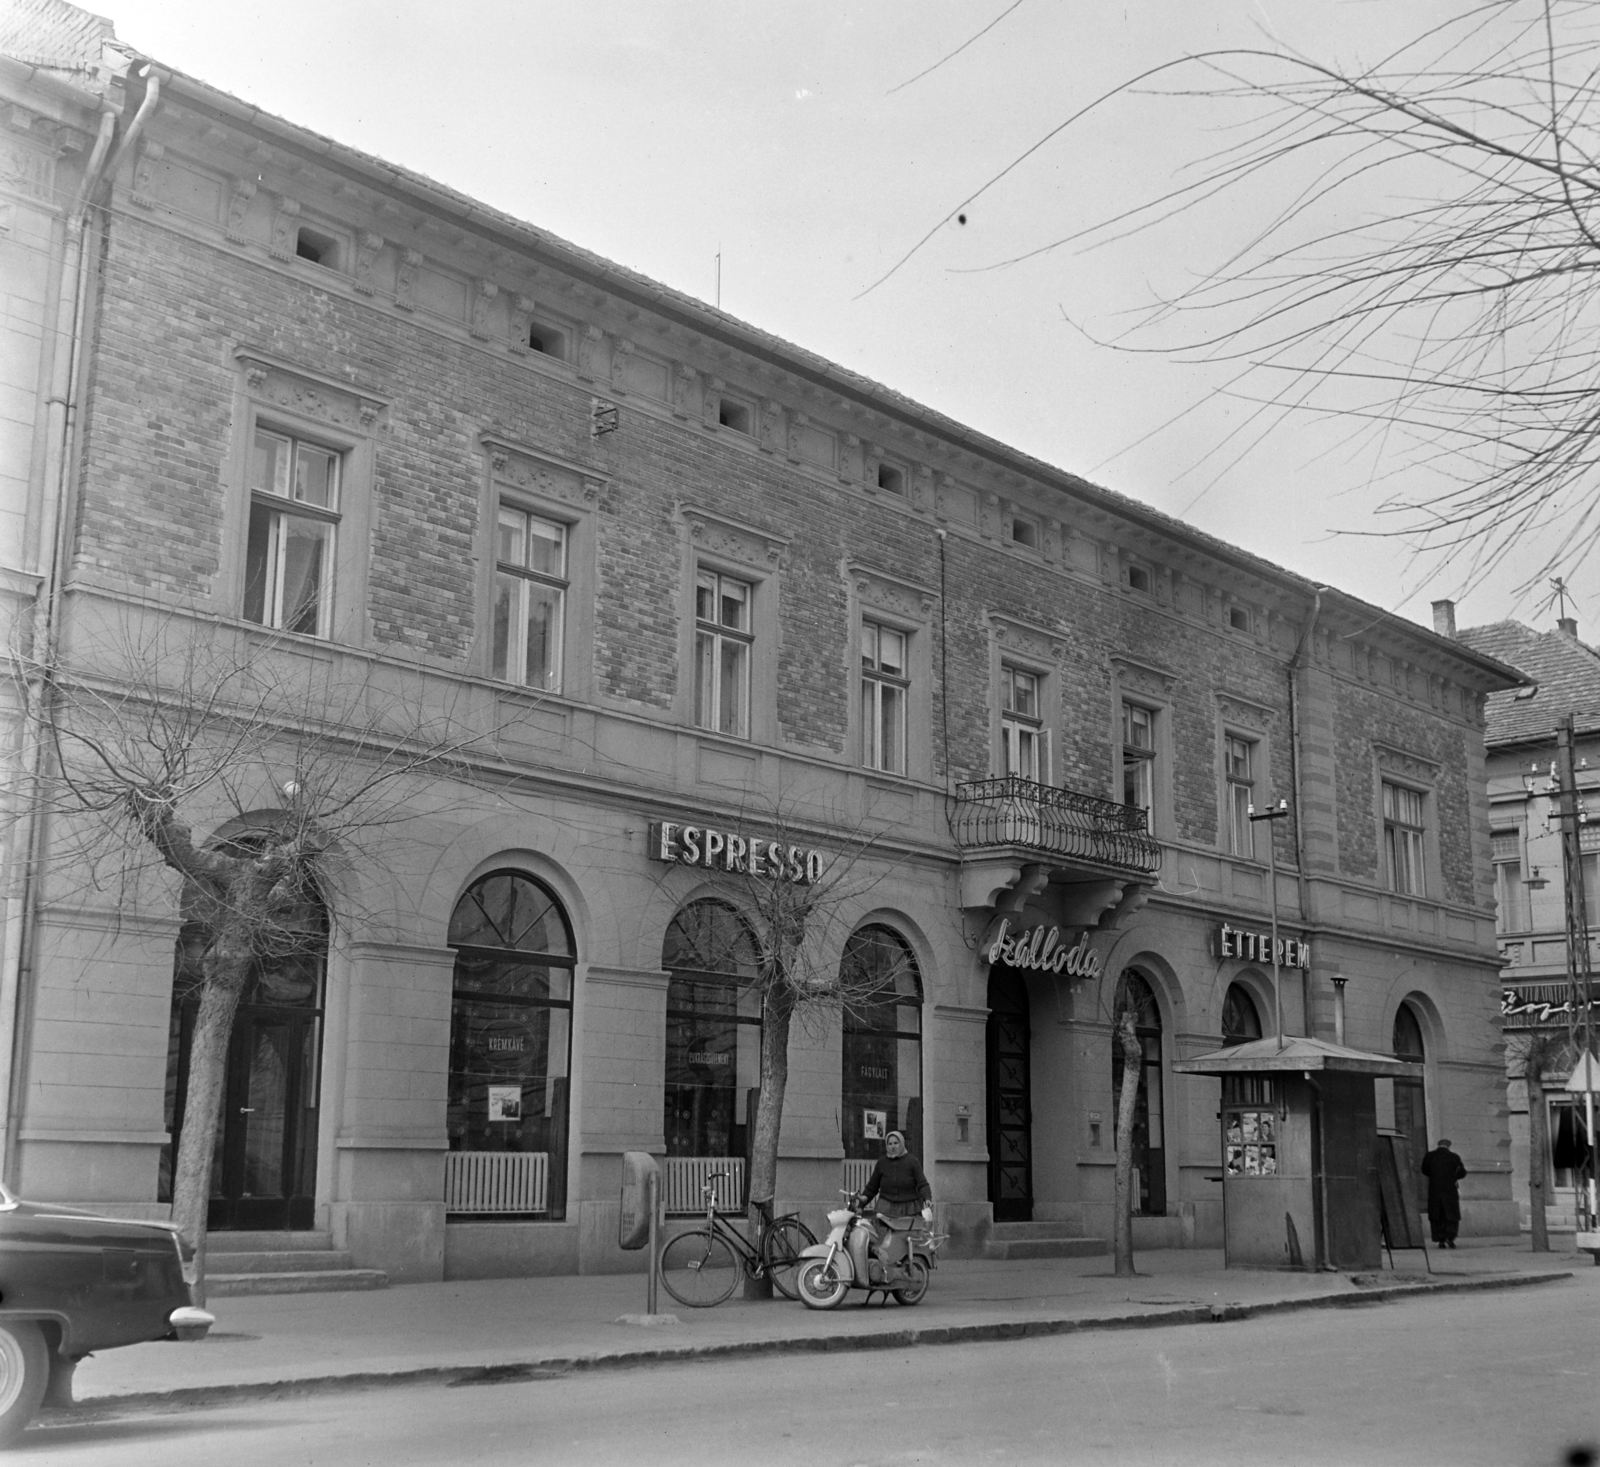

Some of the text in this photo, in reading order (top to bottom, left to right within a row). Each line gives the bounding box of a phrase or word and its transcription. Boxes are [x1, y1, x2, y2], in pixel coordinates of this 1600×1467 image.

[660, 821, 823, 885] ESPRESSO
[1221, 922, 1310, 969] ÉTTEREM
[488, 1034, 524, 1052] KRÉMKÁVÉ
[860, 1065, 888, 1080] FAGYLALT
